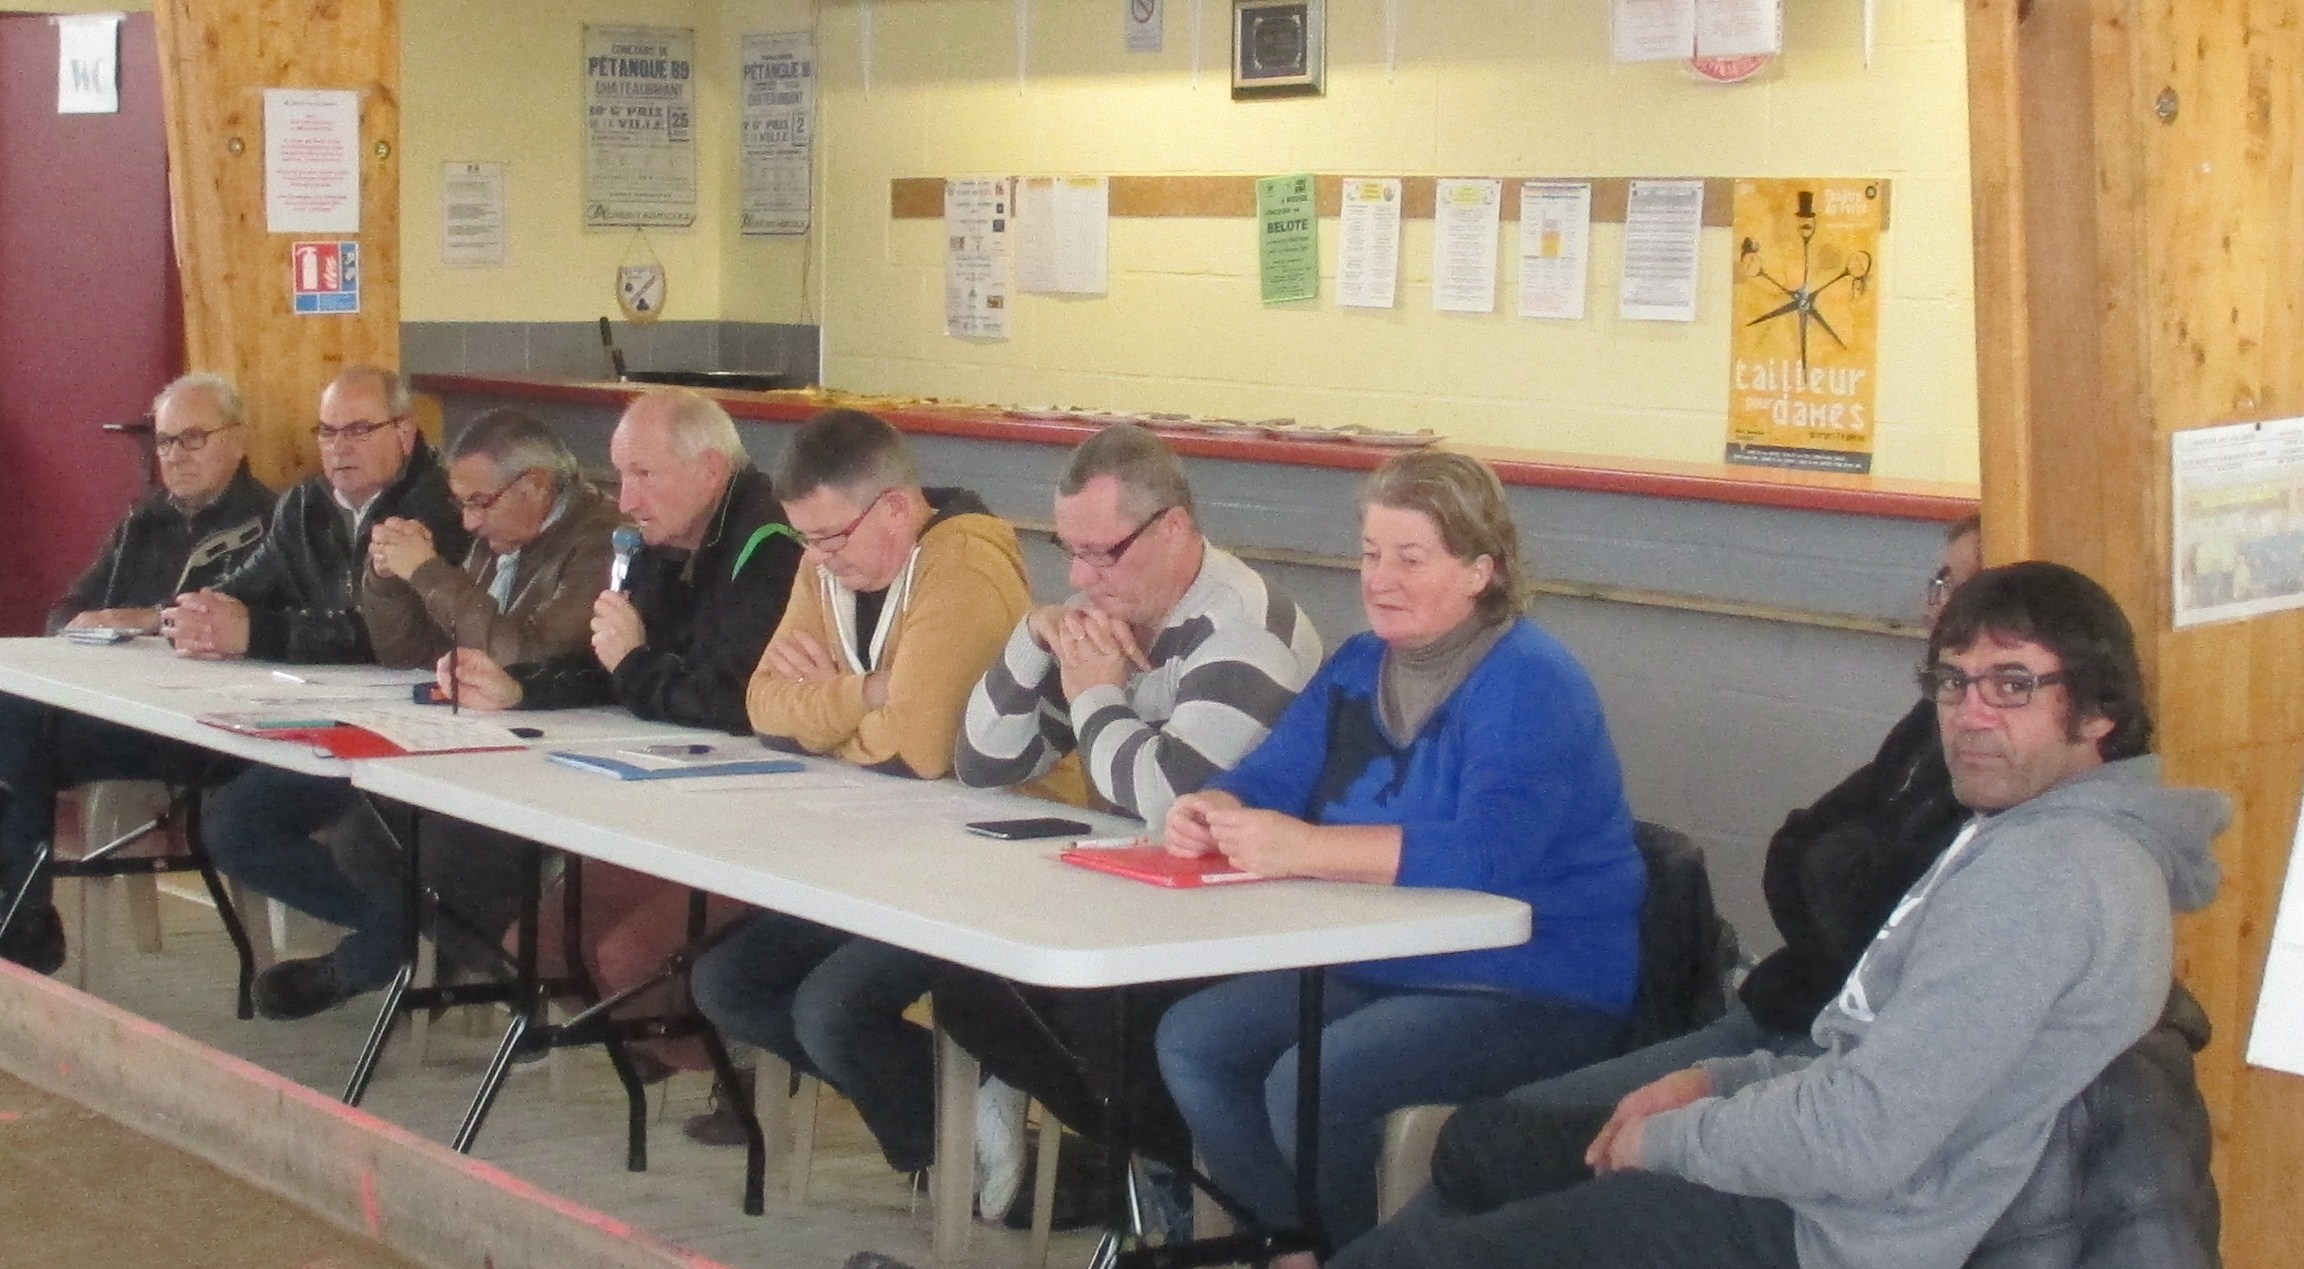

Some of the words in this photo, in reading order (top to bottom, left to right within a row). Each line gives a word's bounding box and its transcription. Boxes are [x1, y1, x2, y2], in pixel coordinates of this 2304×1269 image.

[71, 57, 105, 93] WC
[588, 55, 667, 79] PÉTANQUE
[743, 61, 799, 80] PÉTANQUE
[672, 112, 689, 128] 25
[797, 116, 805, 134] 2
[1266, 218, 1309, 234] BELOTE
[1735, 357, 1865, 396] tailleur
